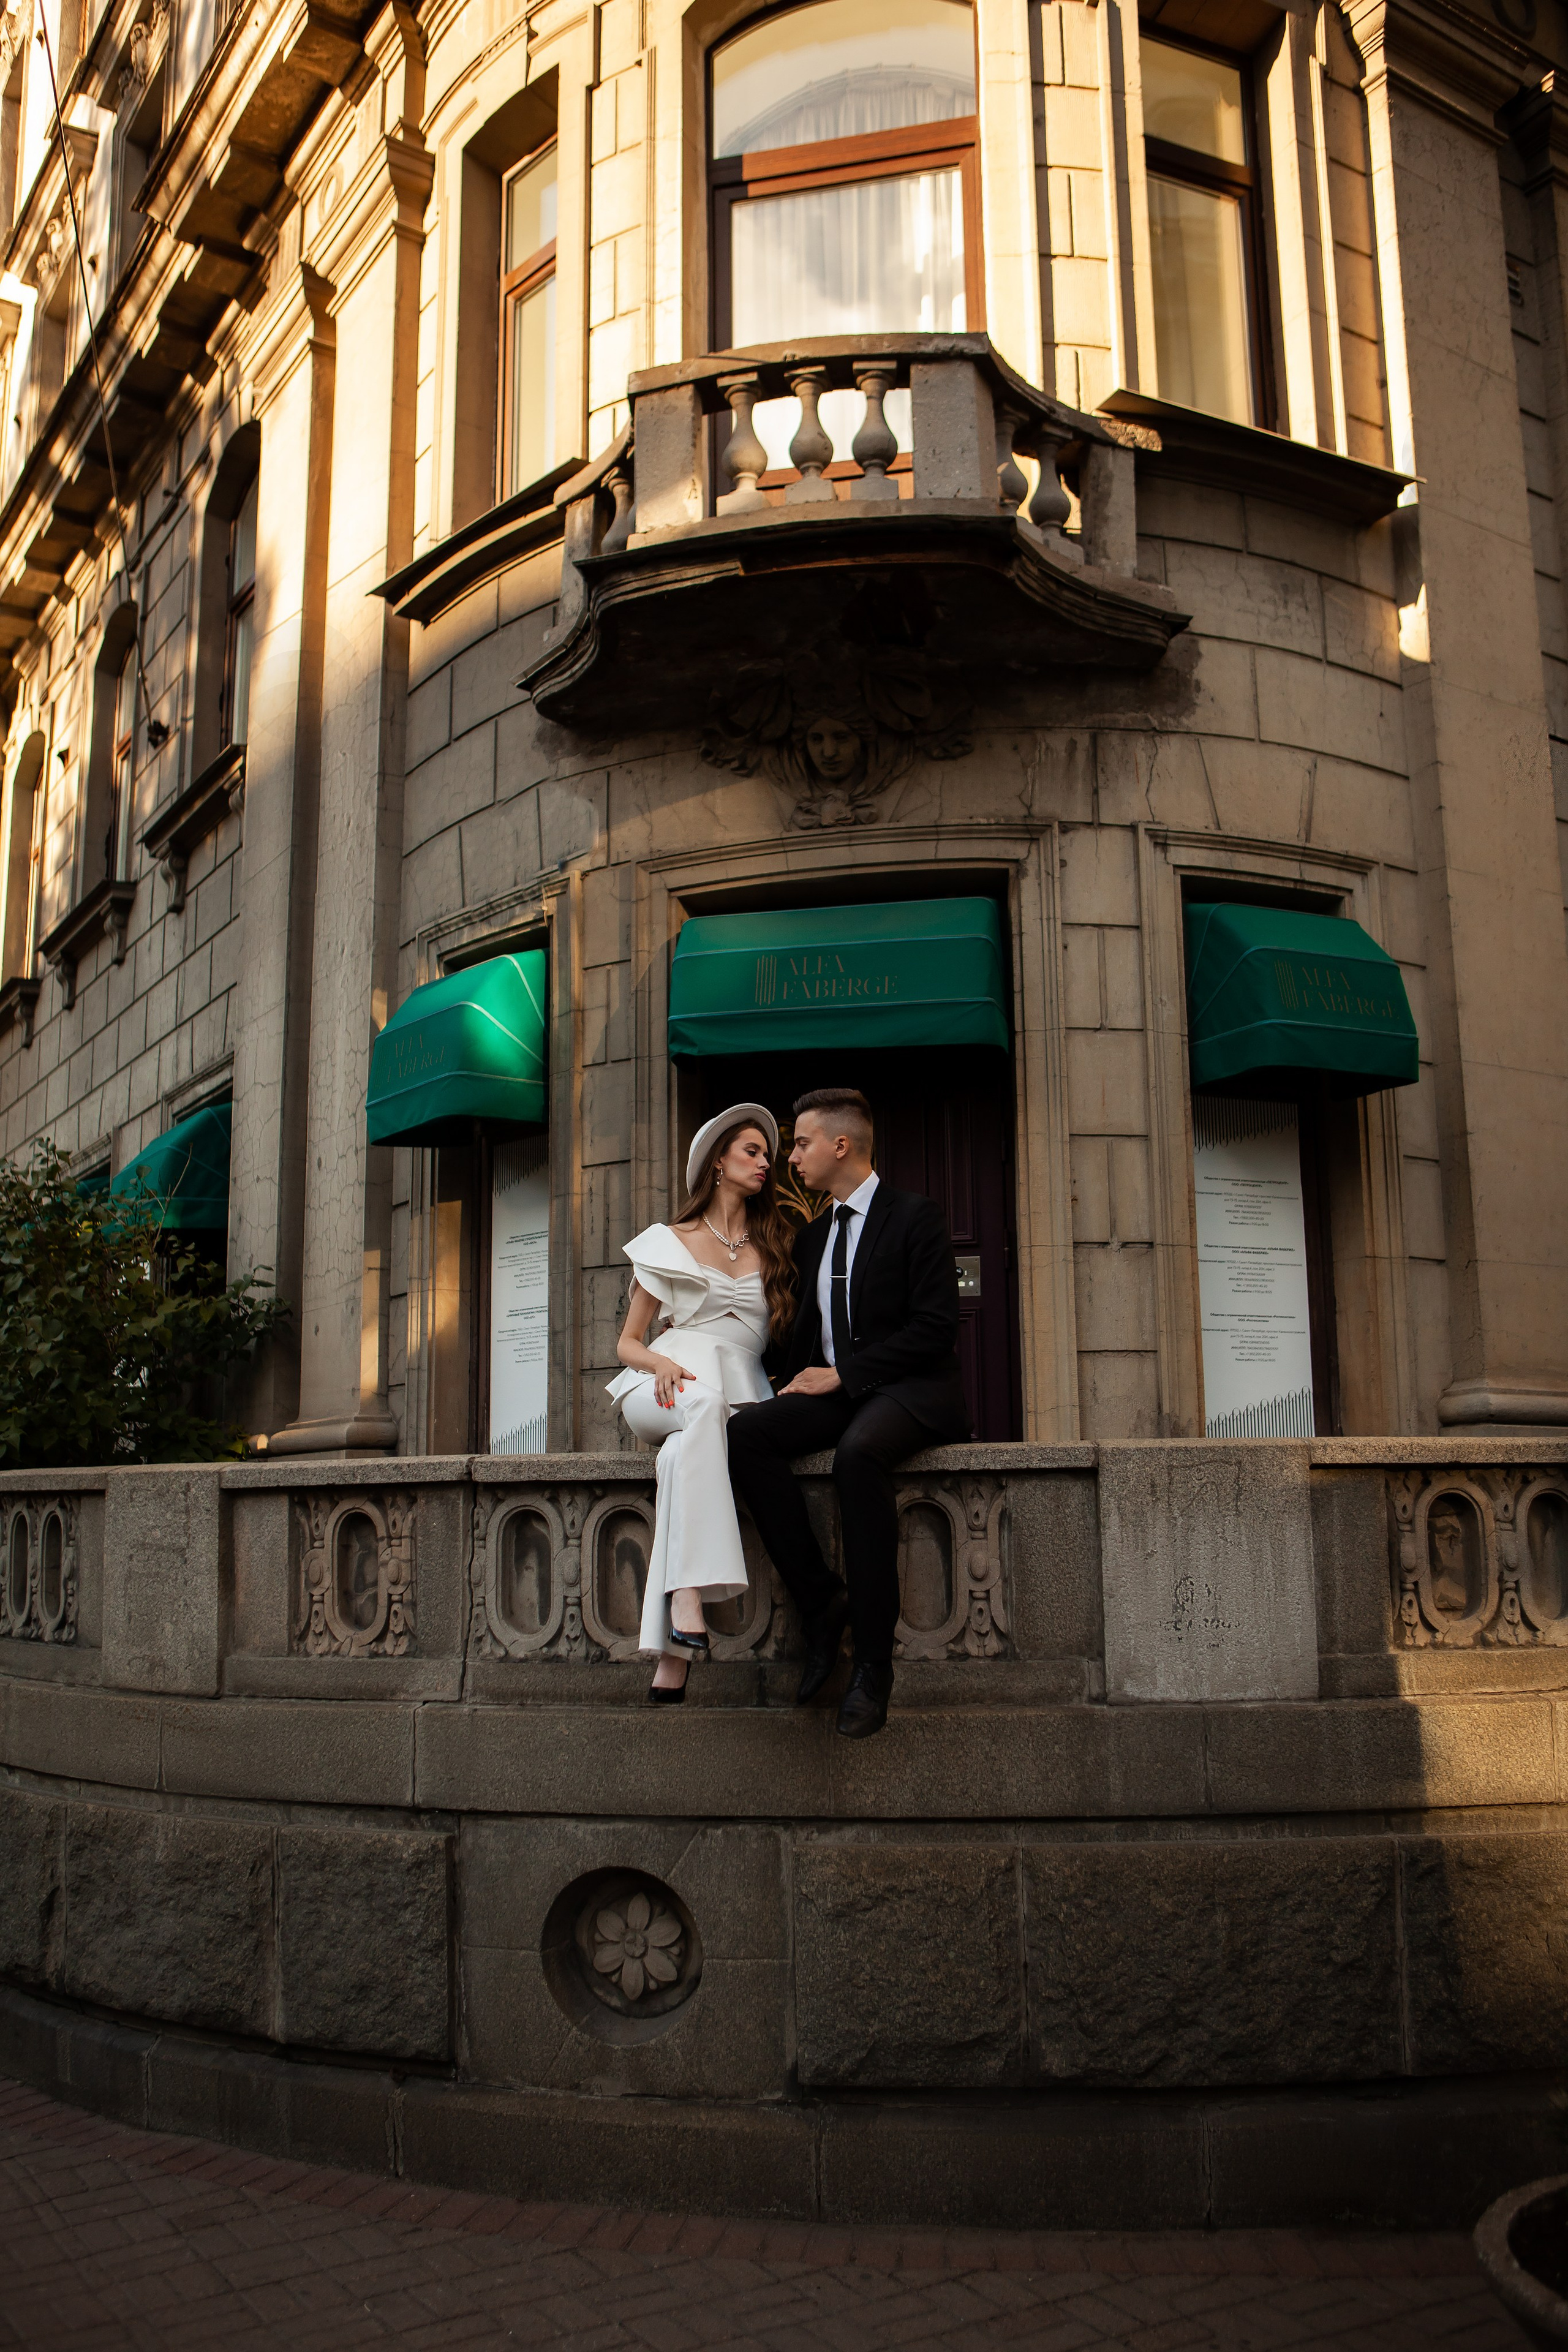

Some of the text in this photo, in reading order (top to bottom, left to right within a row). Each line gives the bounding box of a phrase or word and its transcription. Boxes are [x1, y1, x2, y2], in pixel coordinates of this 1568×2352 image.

[785, 955, 845, 976] ALFA
[782, 976, 898, 1000] FABERGE
[1300, 966, 1351, 991] ALFA
[1303, 990, 1400, 1020] FABERGE
